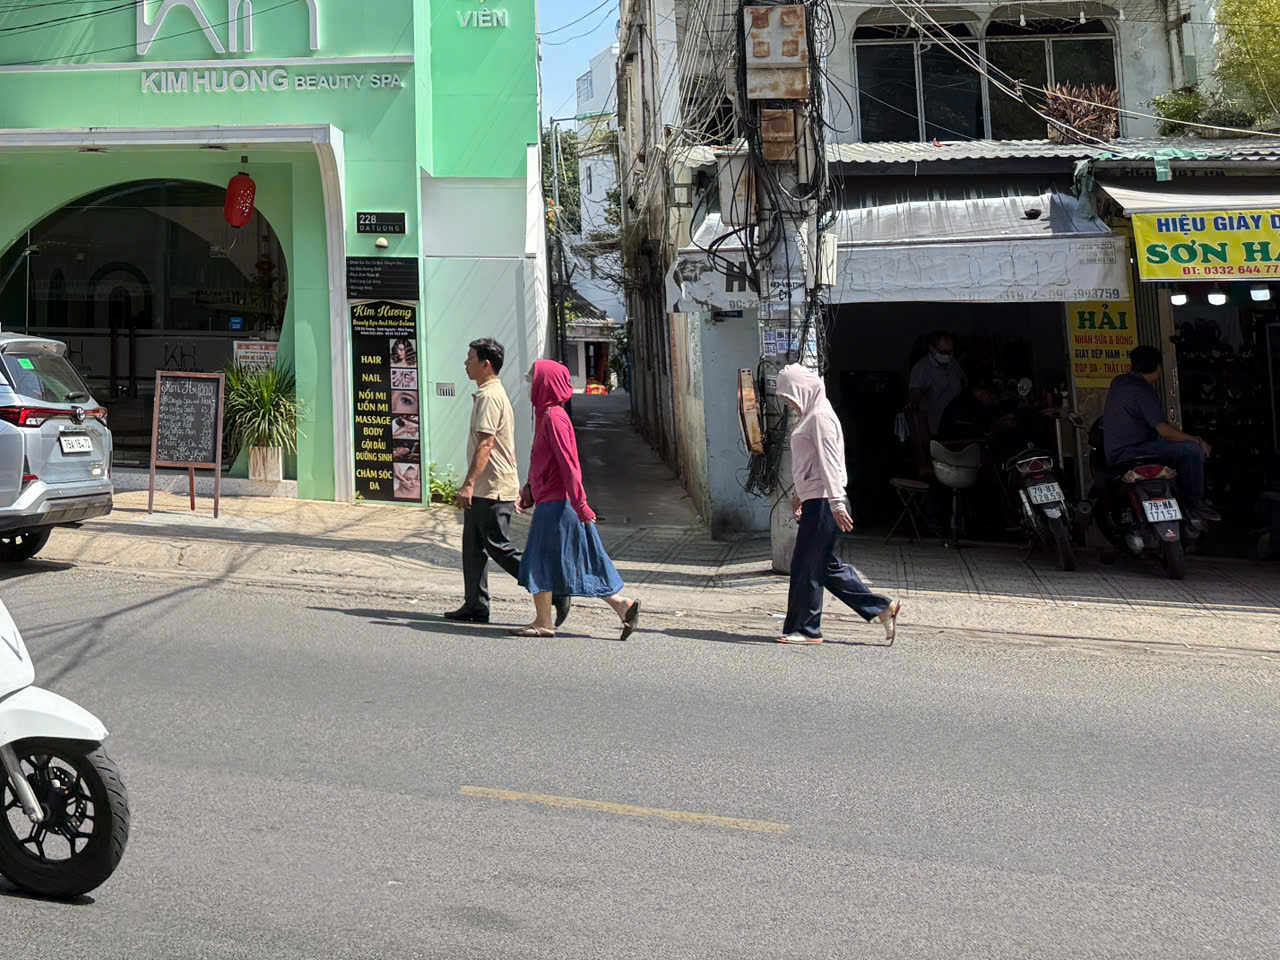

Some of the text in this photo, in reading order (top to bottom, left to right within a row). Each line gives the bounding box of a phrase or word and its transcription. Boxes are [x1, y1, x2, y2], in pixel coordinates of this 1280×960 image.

[456, 5, 509, 28] VIÊN
[141, 69, 403, 93] KIM HUONG BEAUTY SPA
[360, 215, 377, 224] 228
[1156, 214, 1206, 235] HIỆU
[1213, 213, 1262, 230] GIÀY
[1146, 240, 1228, 264] SƠN
[1183, 266, 1200, 275] ĐT:
[1204, 266, 1234, 275] 0332
[1238, 266, 1261, 274] 644
[354, 305, 375, 317] Kim
[1077, 303, 1128, 330] HẢI
[361, 355, 382, 364] HAIR
[362, 373, 382, 382] NAIL
[359, 389, 387, 400] NỐI MI
[357, 402, 389, 412] UỐN MI
[355, 415, 391, 425] MASSAGE
[363, 427, 384, 436] BODY
[361, 438, 386, 451] GỘI ĐẦU
[378, 453, 393, 462] SINH
[356, 468, 393, 479] CHĂM SÓC
[369, 482, 380, 490] DA
